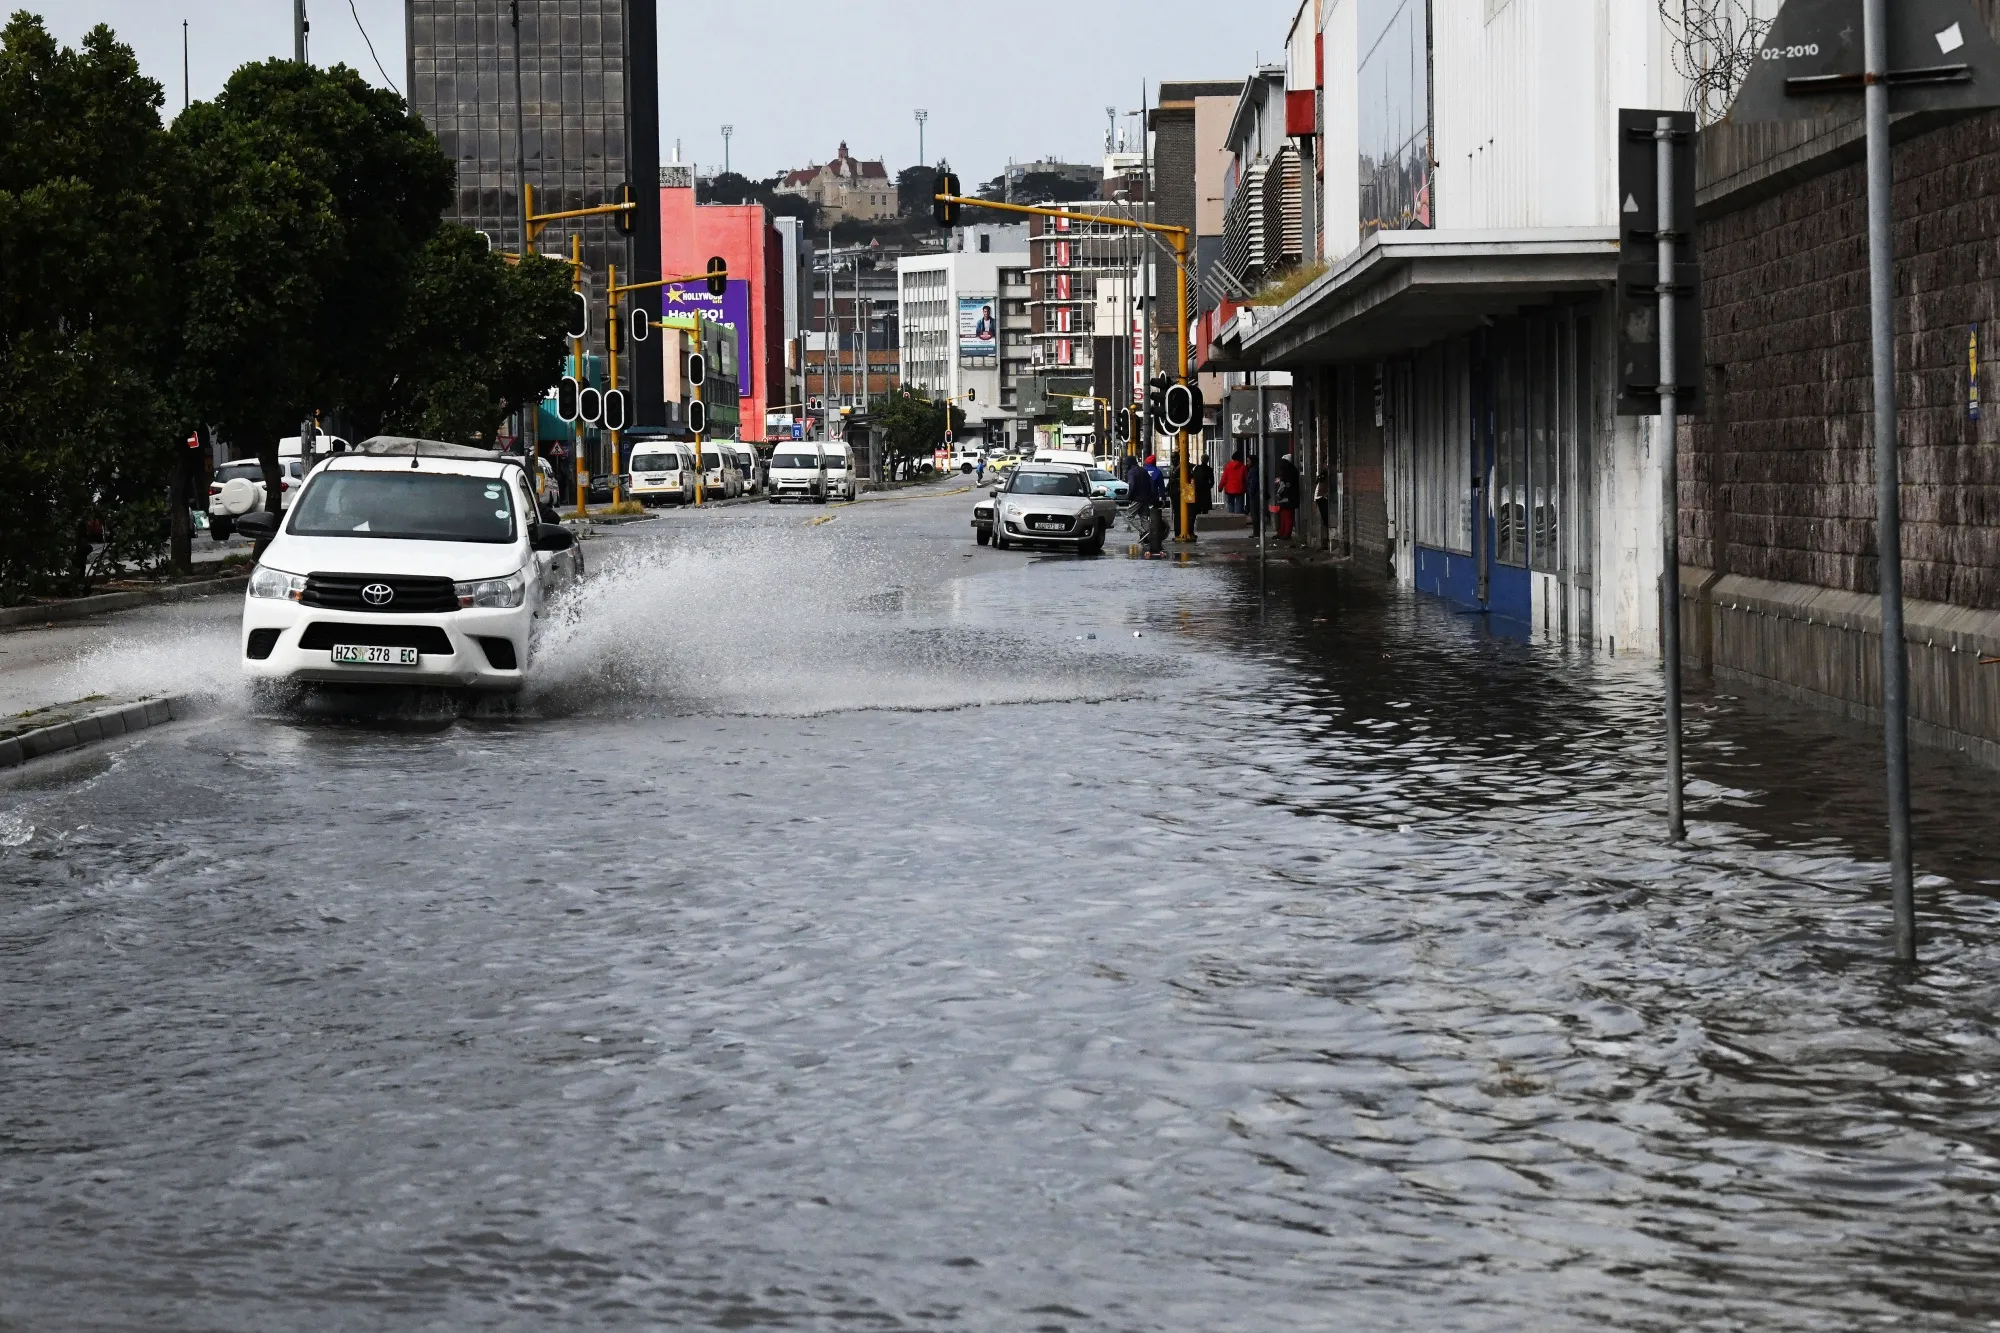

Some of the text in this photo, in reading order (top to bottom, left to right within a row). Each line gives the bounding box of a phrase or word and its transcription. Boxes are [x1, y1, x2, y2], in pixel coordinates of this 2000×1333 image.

[1762, 43, 1819, 60] 02-2010
[1132, 319, 1144, 400] LEWIS
[336, 646, 415, 663] HZS 378 EC
